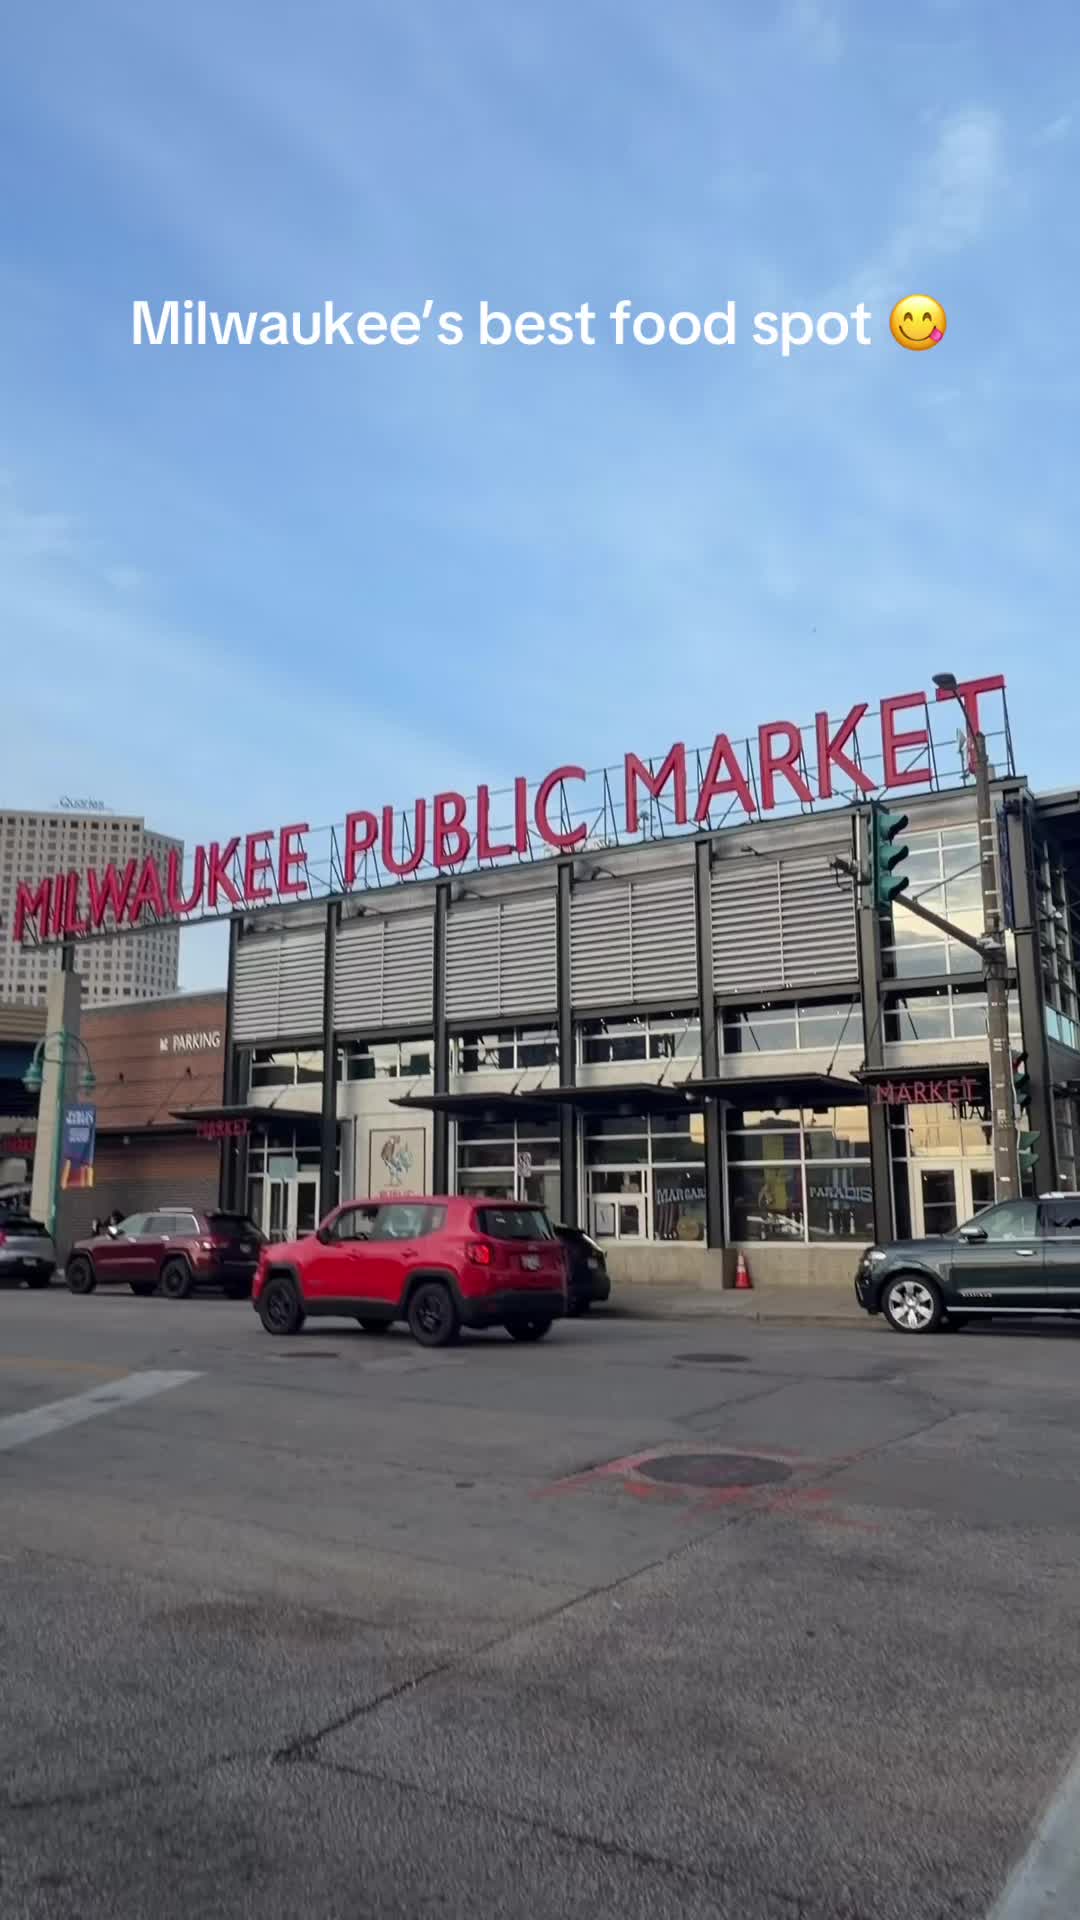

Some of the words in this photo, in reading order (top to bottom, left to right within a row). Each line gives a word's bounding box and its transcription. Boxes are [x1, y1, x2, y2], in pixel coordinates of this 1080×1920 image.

[13, 823, 310, 944] MILWAUKEE
[344, 765, 588, 892] PUBLIC
[625, 675, 1005, 834] MARKET
[172, 1031, 221, 1052] PARKING
[876, 1078, 977, 1104] MARKET
